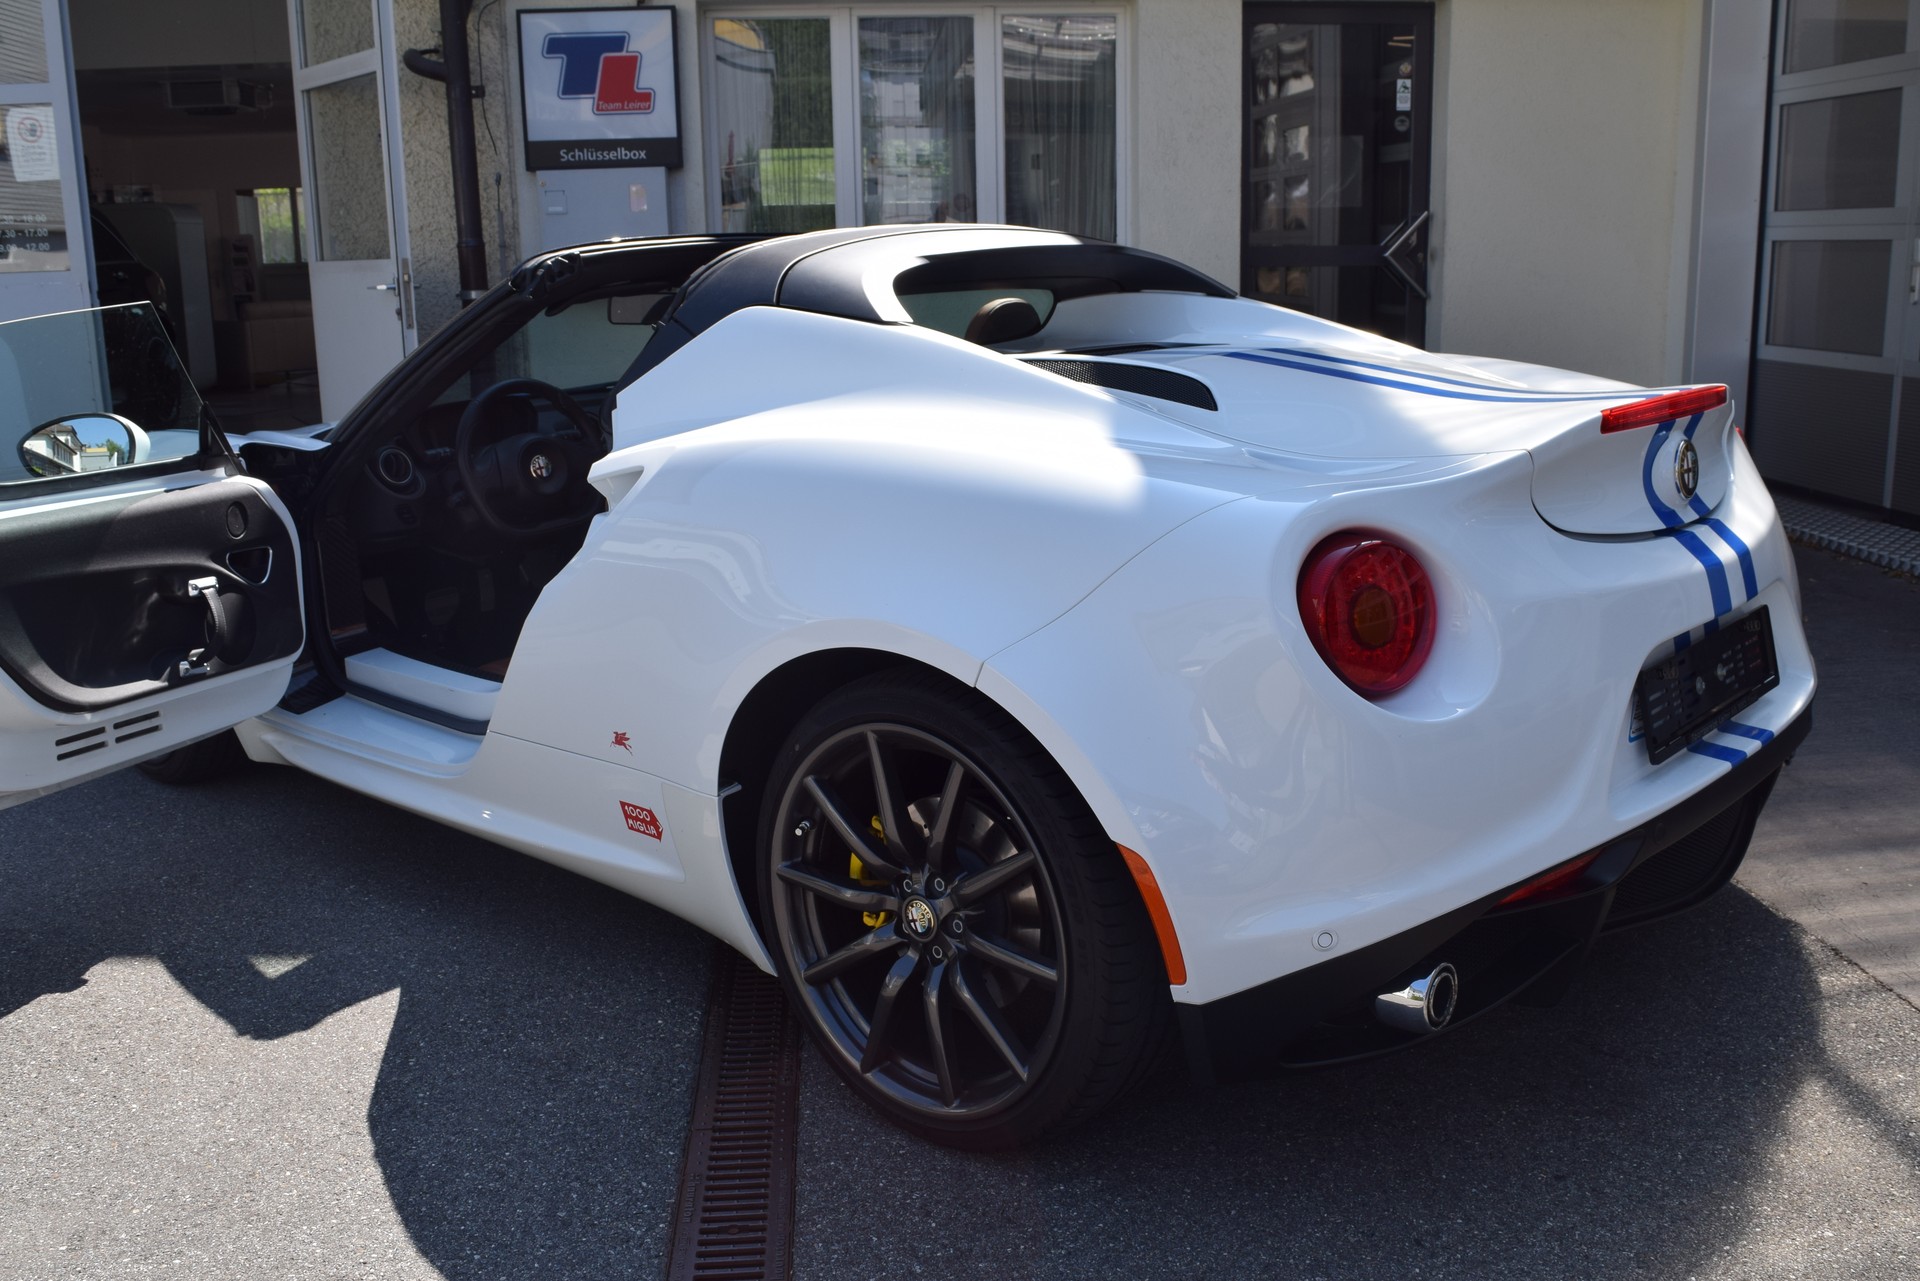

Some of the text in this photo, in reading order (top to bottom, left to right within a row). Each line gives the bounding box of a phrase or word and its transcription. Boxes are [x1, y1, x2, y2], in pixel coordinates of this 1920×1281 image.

[598, 100, 651, 110] Team Leirer
[559, 147, 647, 162] Schlüsselbox
[24, 228, 49, 238] 17.00
[625, 805, 651, 821] 1000
